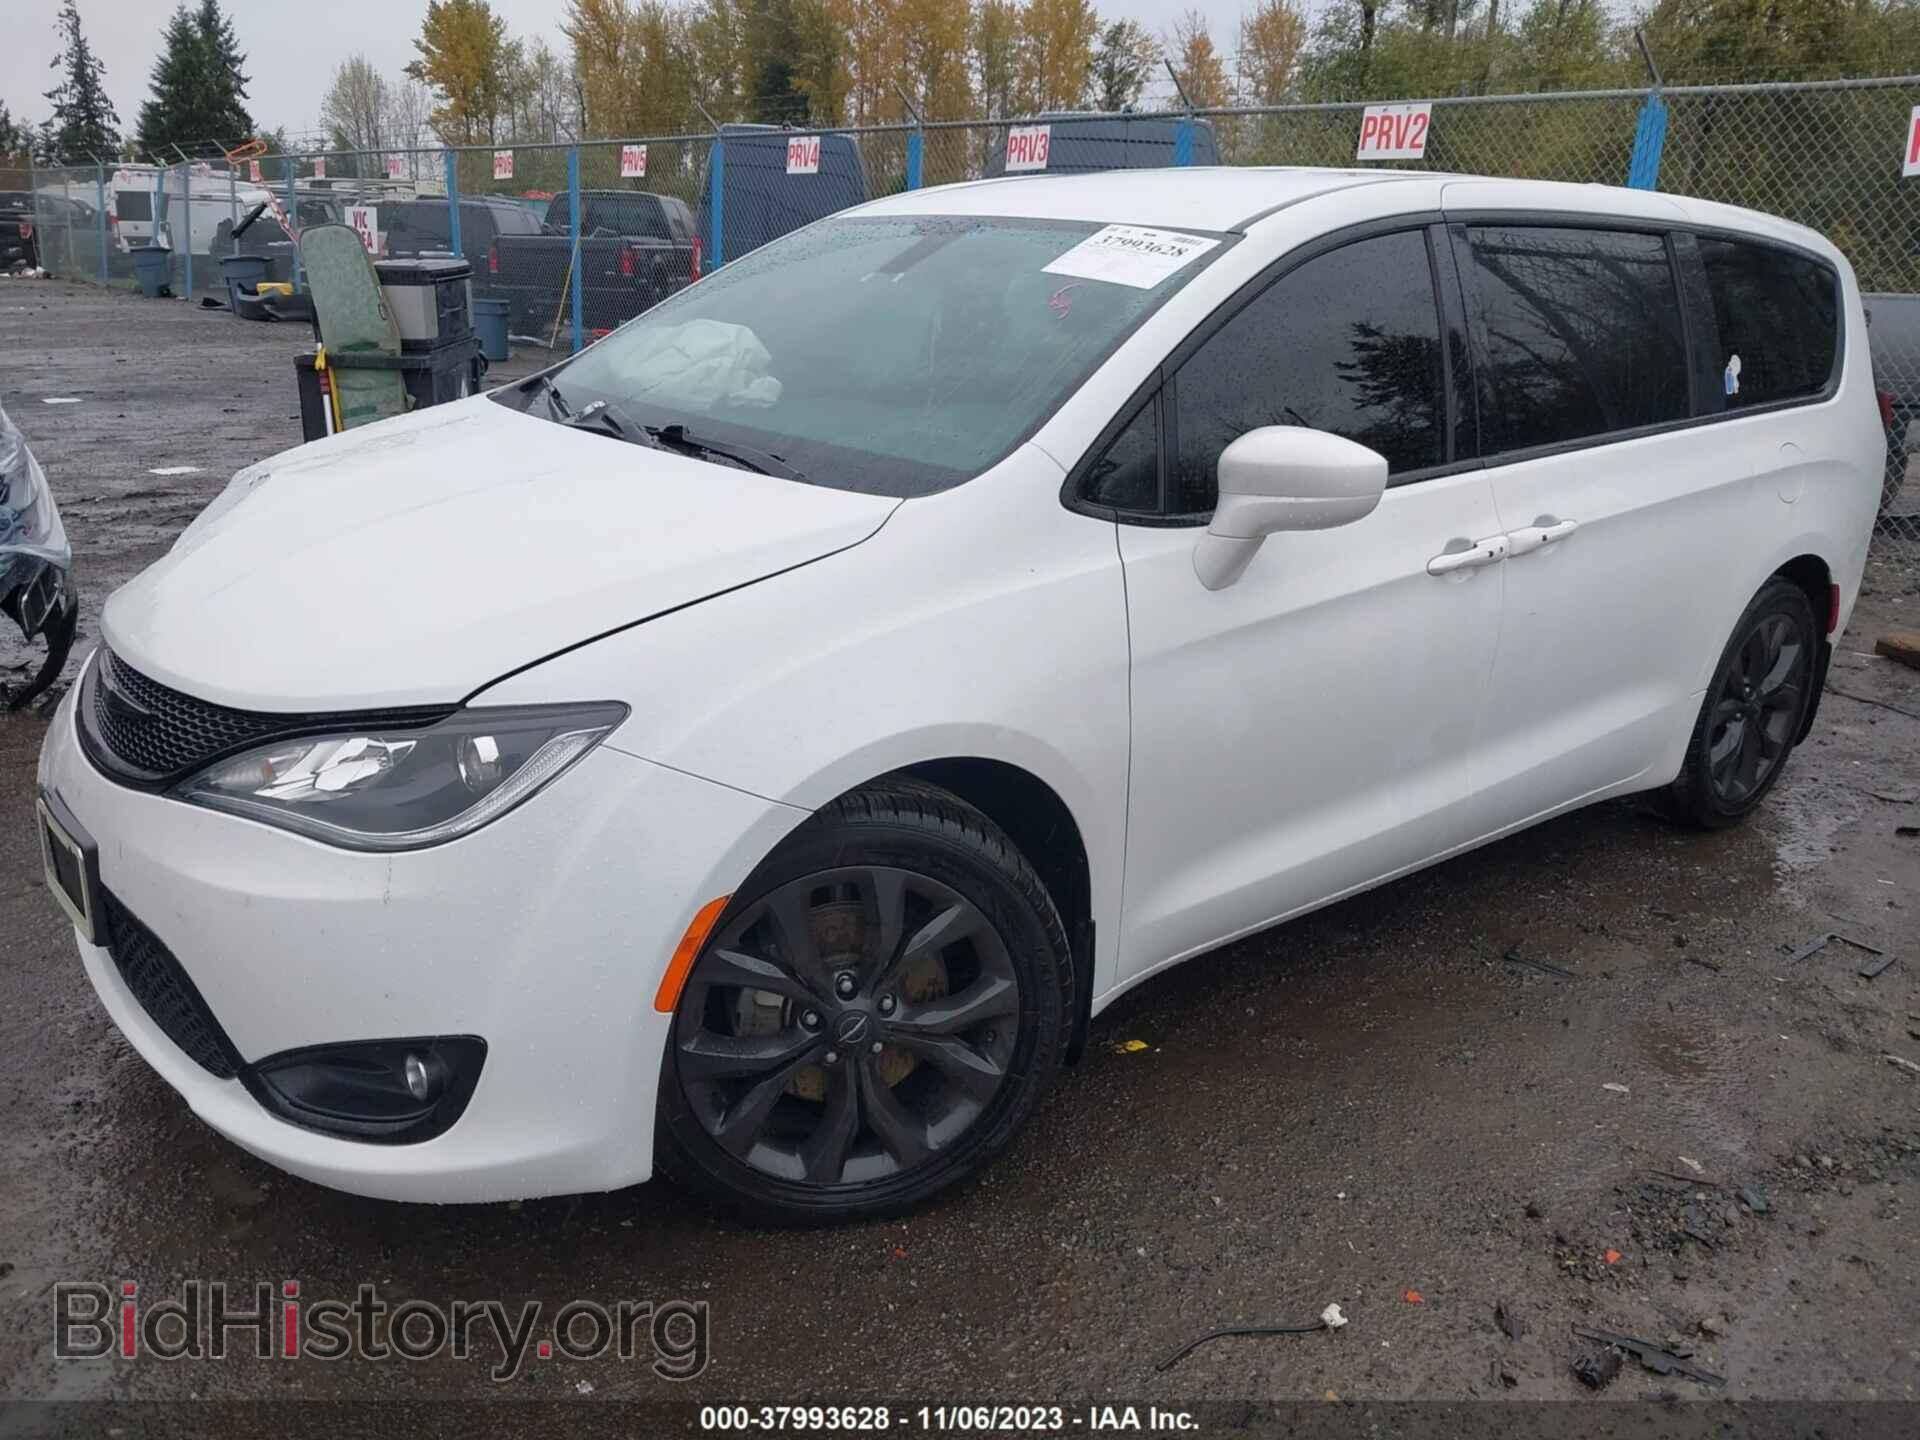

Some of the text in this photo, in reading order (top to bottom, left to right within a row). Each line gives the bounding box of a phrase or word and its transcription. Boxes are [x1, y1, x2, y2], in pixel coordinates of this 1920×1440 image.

[1360, 112, 1428, 150] PRV2
[622, 150, 646, 172] PRV5
[787, 143, 819, 168] PRV4
[1007, 133, 1048, 163] PRV3
